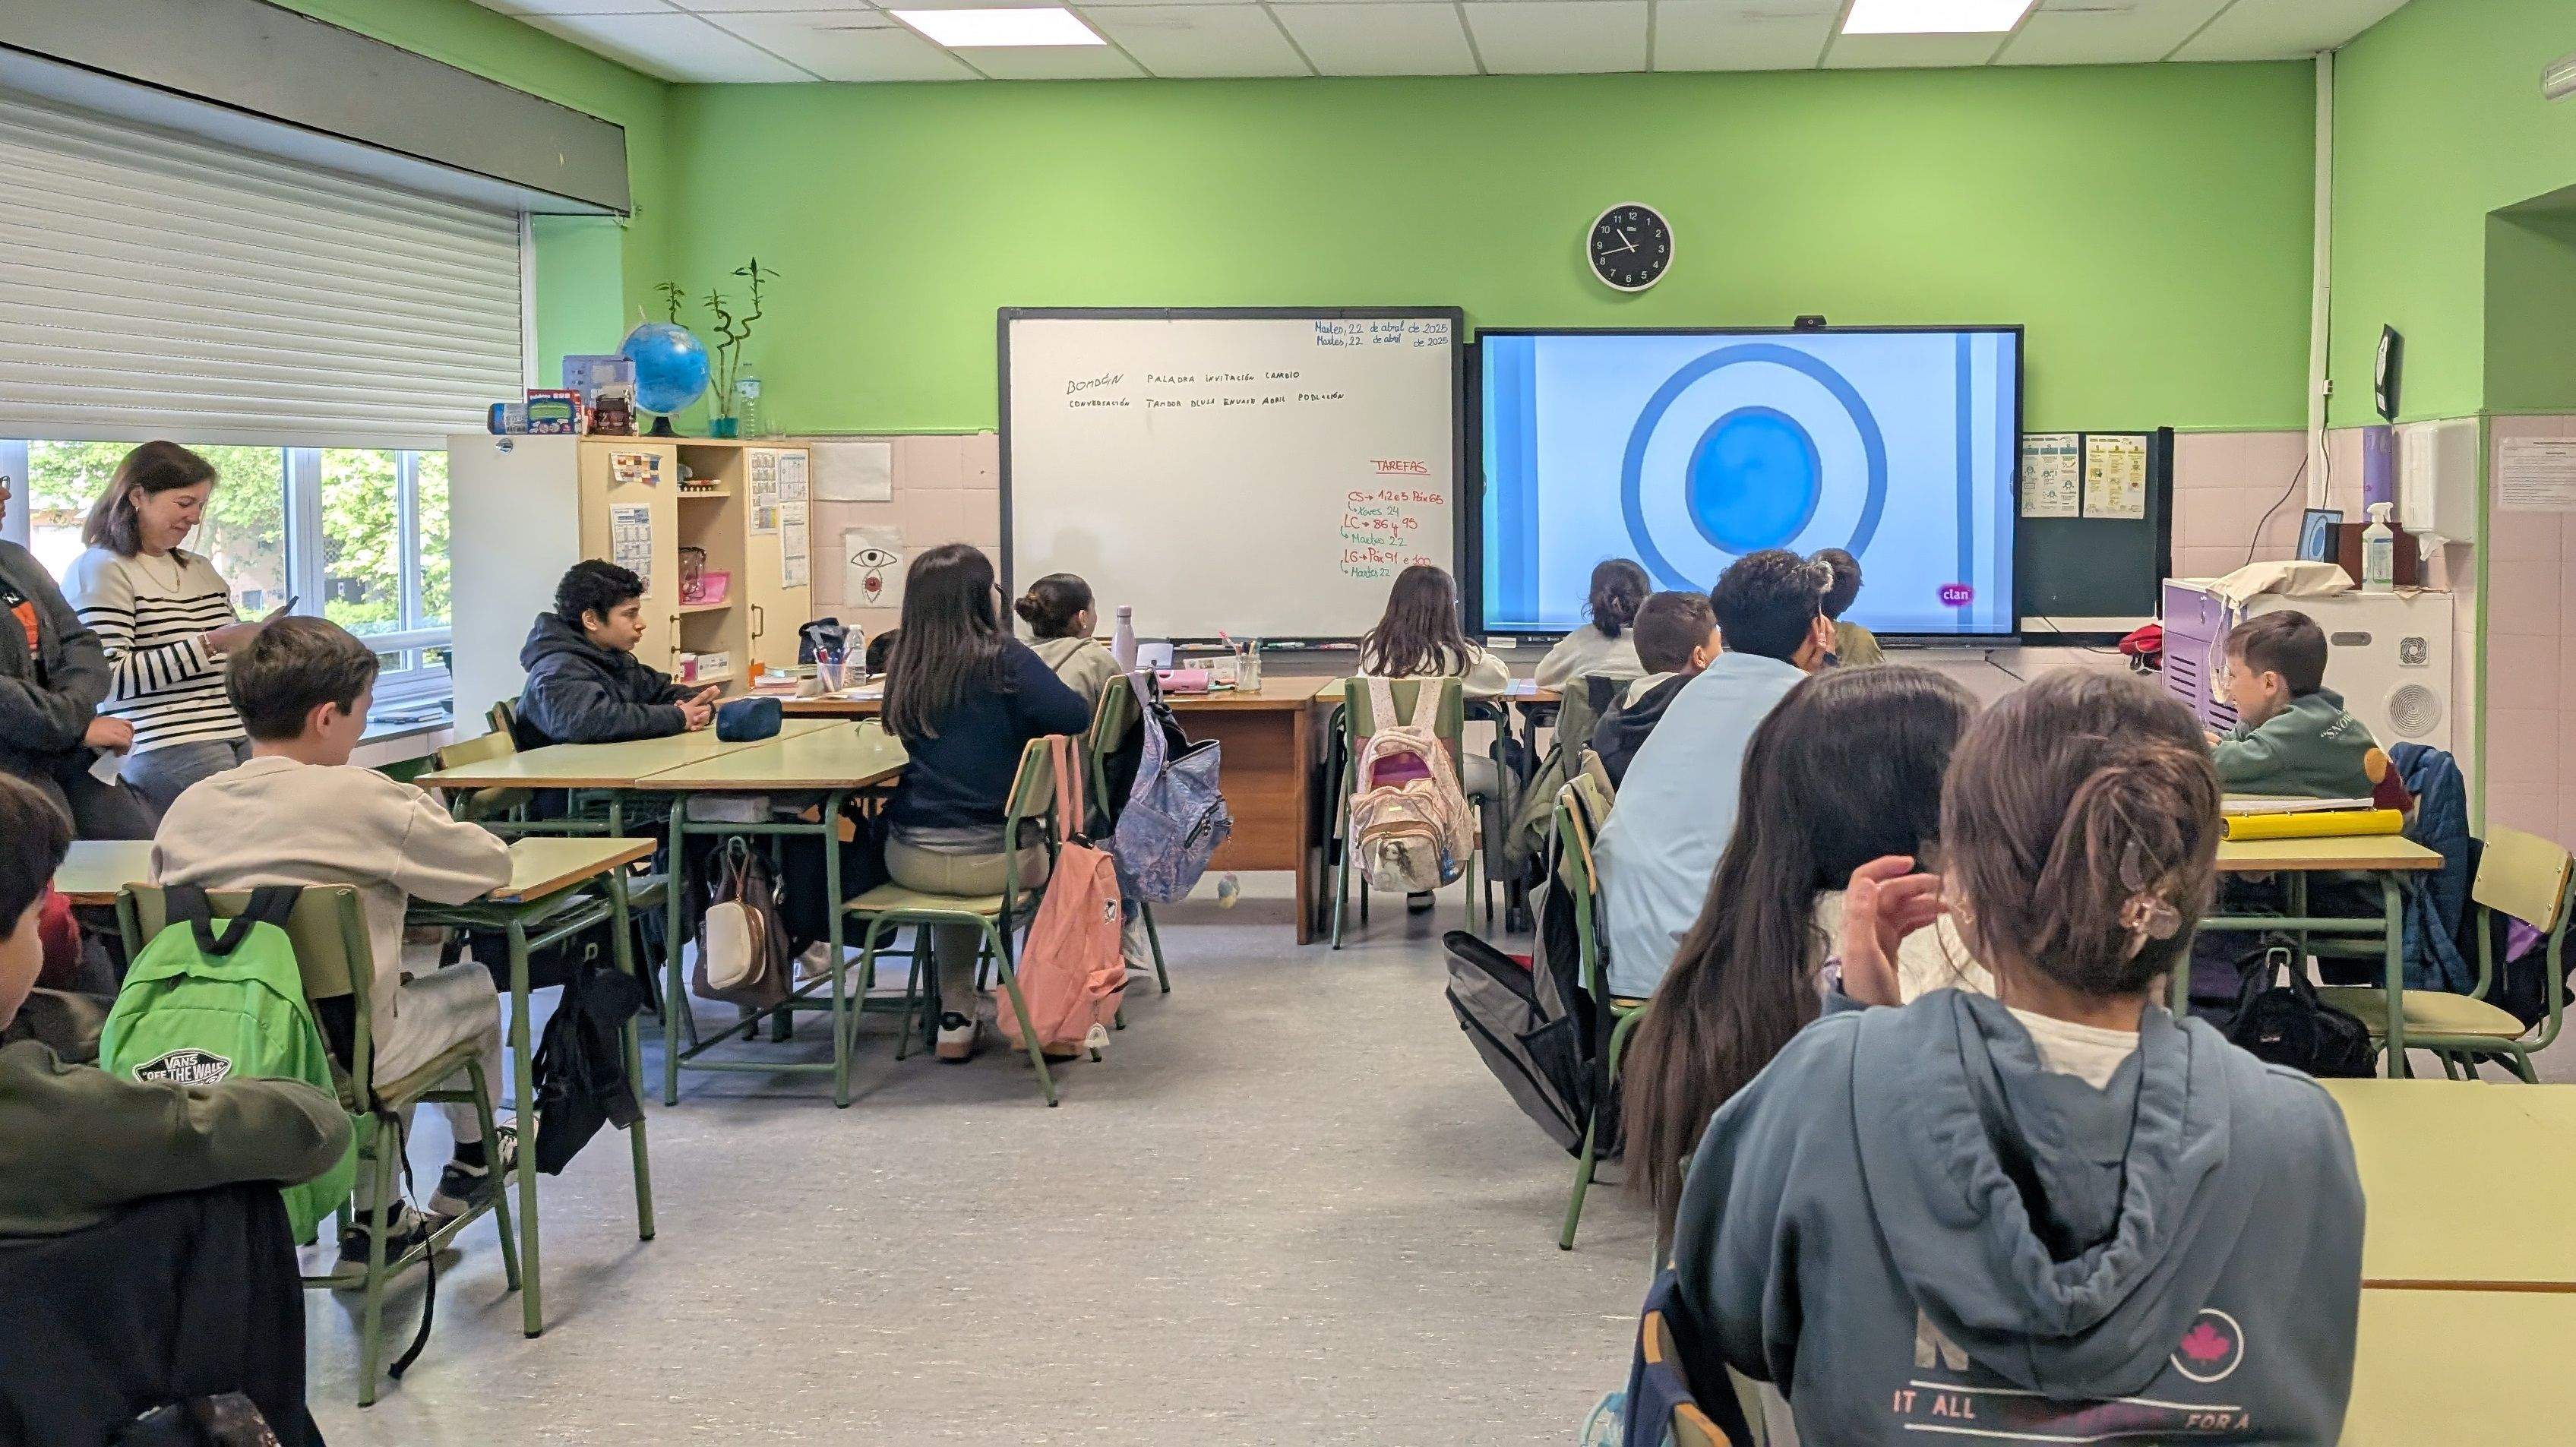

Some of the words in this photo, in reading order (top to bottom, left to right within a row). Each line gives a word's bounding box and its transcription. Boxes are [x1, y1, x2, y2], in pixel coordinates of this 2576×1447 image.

[1614, 215, 1622, 223] 11
[1628, 212, 1638, 220] 12
[1646, 217, 1651, 226] 1
[1601, 226, 1610, 234] 10
[1655, 229, 1661, 238] 2
[1658, 245, 1664, 253] 3
[1600, 257, 1606, 265] 8
[1610, 269, 1617, 277] 7
[1626, 274, 1632, 283] 6
[1641, 270, 1648, 280] 5
[1348, 324, 1364, 334] 22
[1370, 321, 1379, 332] de
[1408, 322, 1419, 333] de
[1423, 323, 1449, 334] 2025
[1348, 336, 1364, 346] 22
[1373, 334, 1382, 344] de
[1383, 333, 1401, 344] abril
[1413, 338, 1424, 348] de
[1427, 336, 1449, 346] 2025
[1370, 460, 1428, 473] TAREFAS
[1348, 491, 1364, 502] CS
[1387, 506, 1399, 517] 24
[1344, 514, 1360, 529] LC
[1373, 519, 1389, 529] 86
[1391, 523, 1399, 538] y
[1352, 533, 1384, 546] Martes
[1389, 536, 1407, 547] 22
[1412, 554, 1431, 567] 100
[1352, 566, 1379, 577] Martes
[1380, 567, 1390, 577] 22
[1943, 588, 1968, 600] clan
[164, 1054, 198, 1069] VANS
[167, 1066, 192, 1083] THE
[1892, 1389, 1917, 1414] IT
[1932, 1393, 1976, 1420] ALL
[2183, 1412, 2232, 1430] FOR
[2234, 1411, 2251, 1430] A
